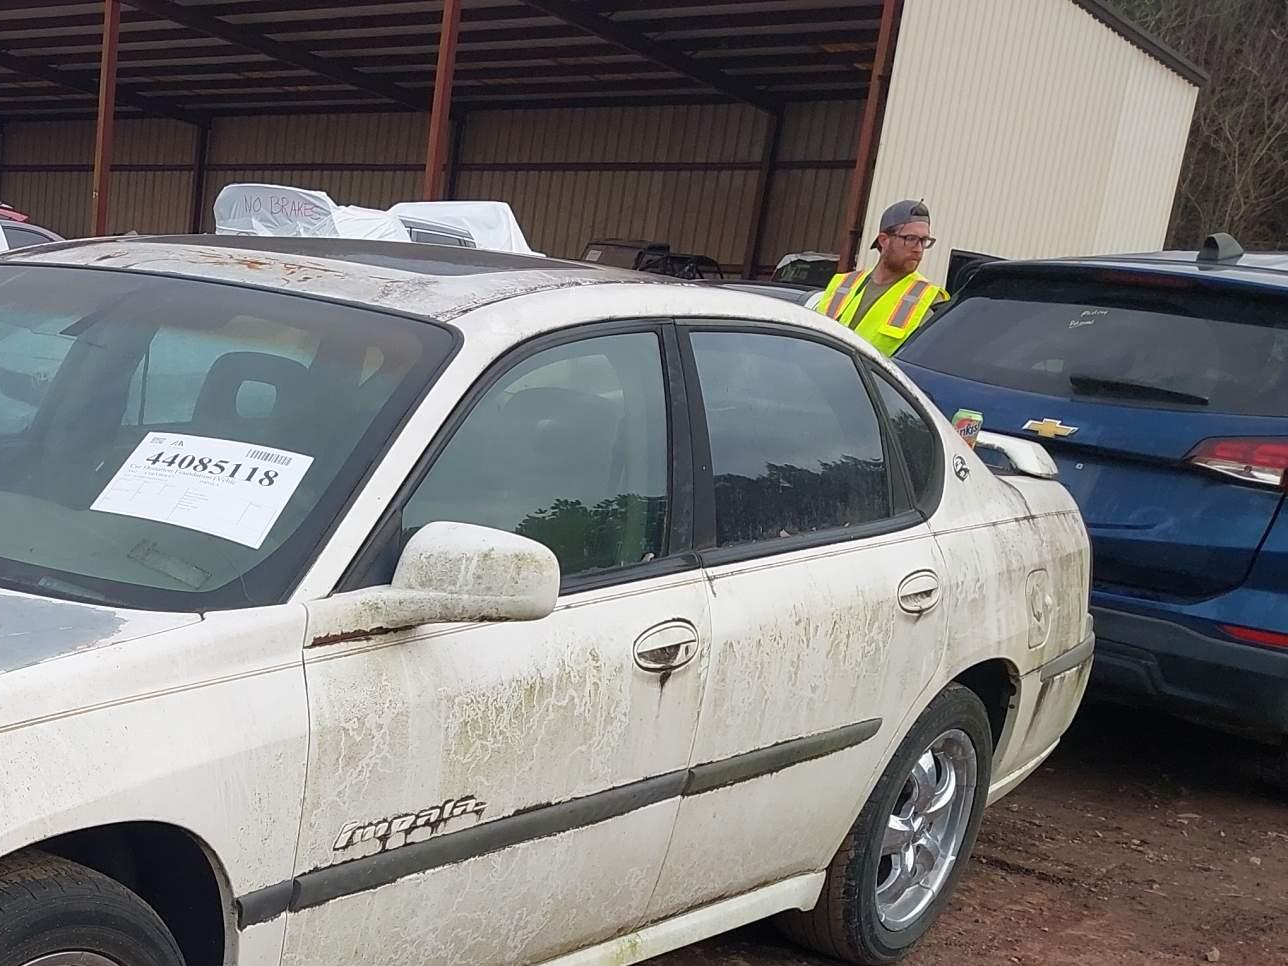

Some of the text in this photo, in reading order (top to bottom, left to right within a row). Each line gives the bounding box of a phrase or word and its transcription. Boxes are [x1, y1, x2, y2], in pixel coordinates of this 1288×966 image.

[244, 194, 321, 220] NO BRAKES
[146, 451, 280, 487] 44085118
